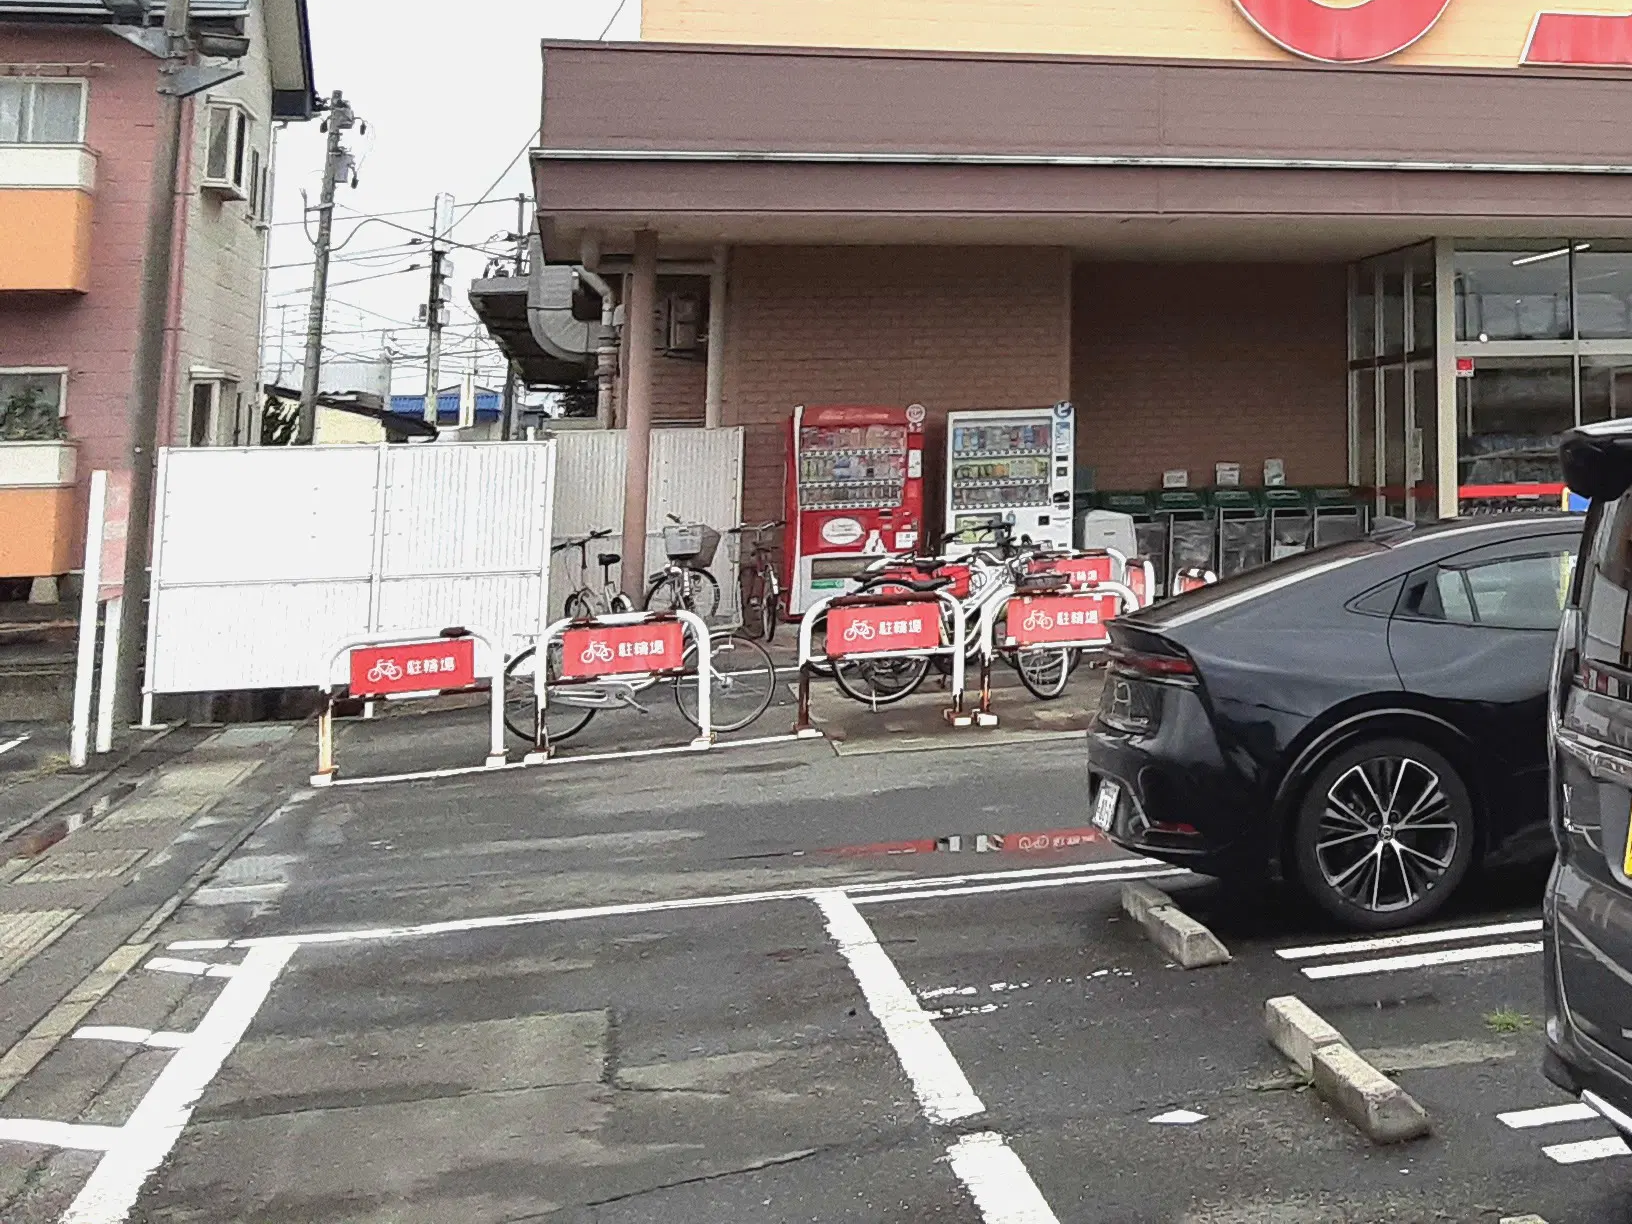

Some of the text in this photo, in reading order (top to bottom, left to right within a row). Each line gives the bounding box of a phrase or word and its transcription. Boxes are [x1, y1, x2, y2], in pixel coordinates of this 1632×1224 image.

[879, 618, 922, 636] 駐輪場
[1056, 610, 1098, 626] 駐輪場
[618, 639, 665, 658] 駐輪場
[406, 656, 456, 675] 駐輪場
